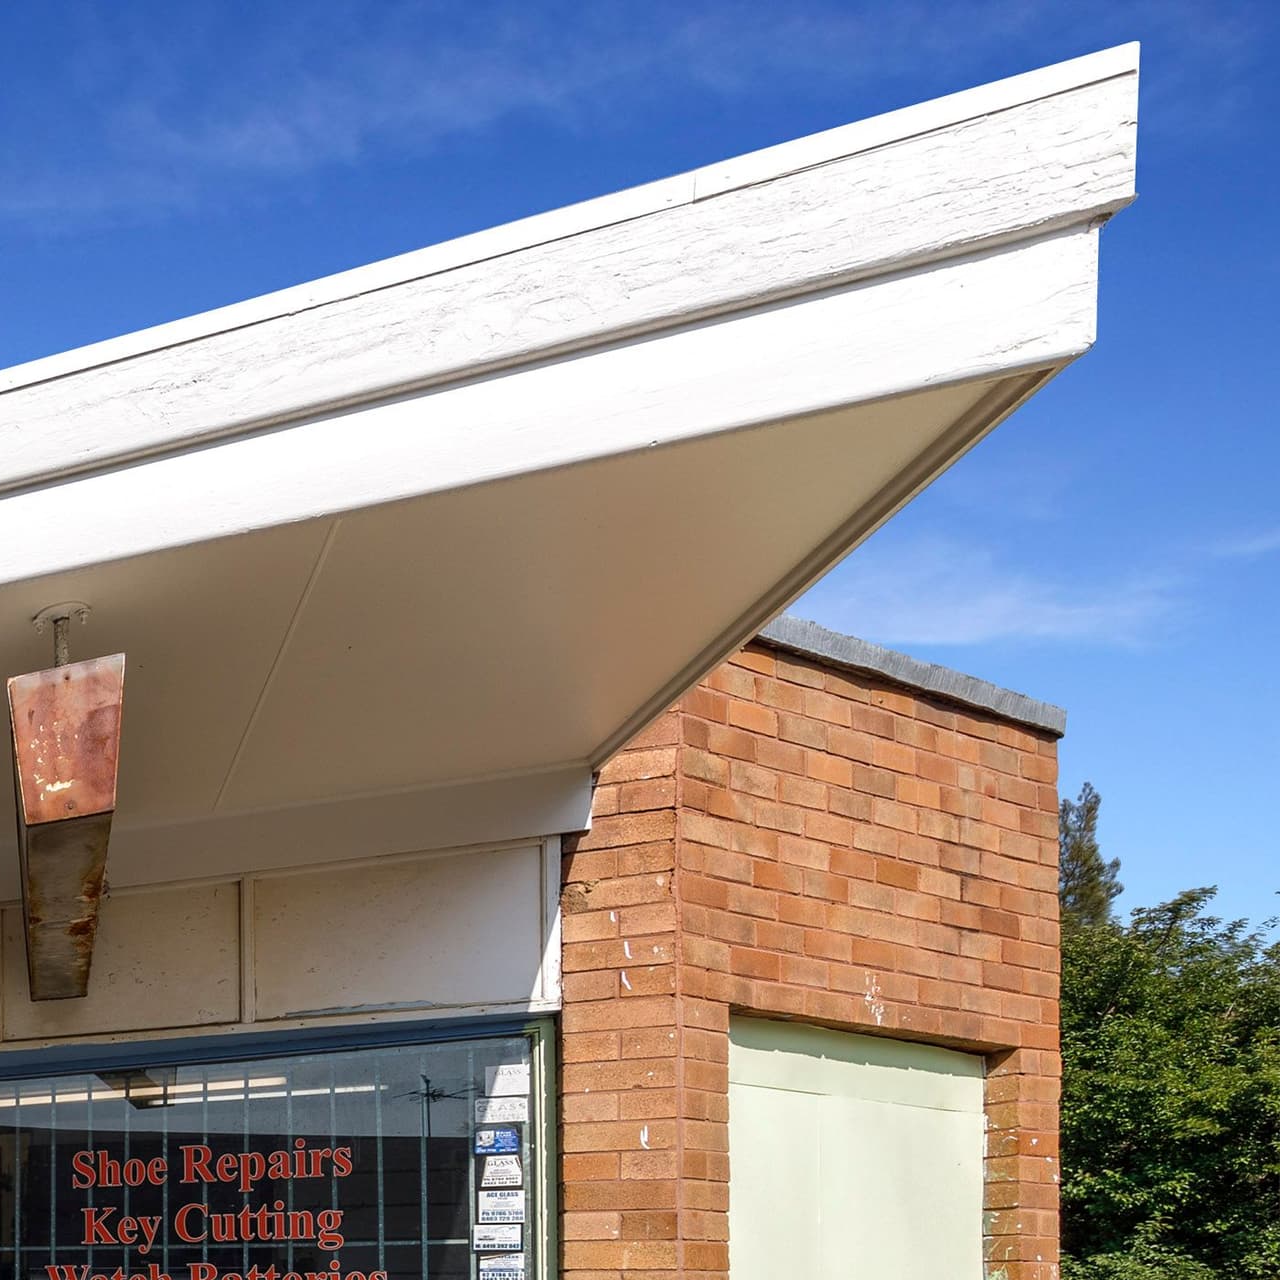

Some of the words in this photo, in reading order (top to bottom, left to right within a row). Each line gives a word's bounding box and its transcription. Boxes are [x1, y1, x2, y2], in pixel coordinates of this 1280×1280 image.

[72, 1150, 168, 1189] Shoe
[180, 1138, 353, 1192] Repairs
[81, 1206, 162, 1254] Key
[175, 1200, 344, 1250] Cutting
